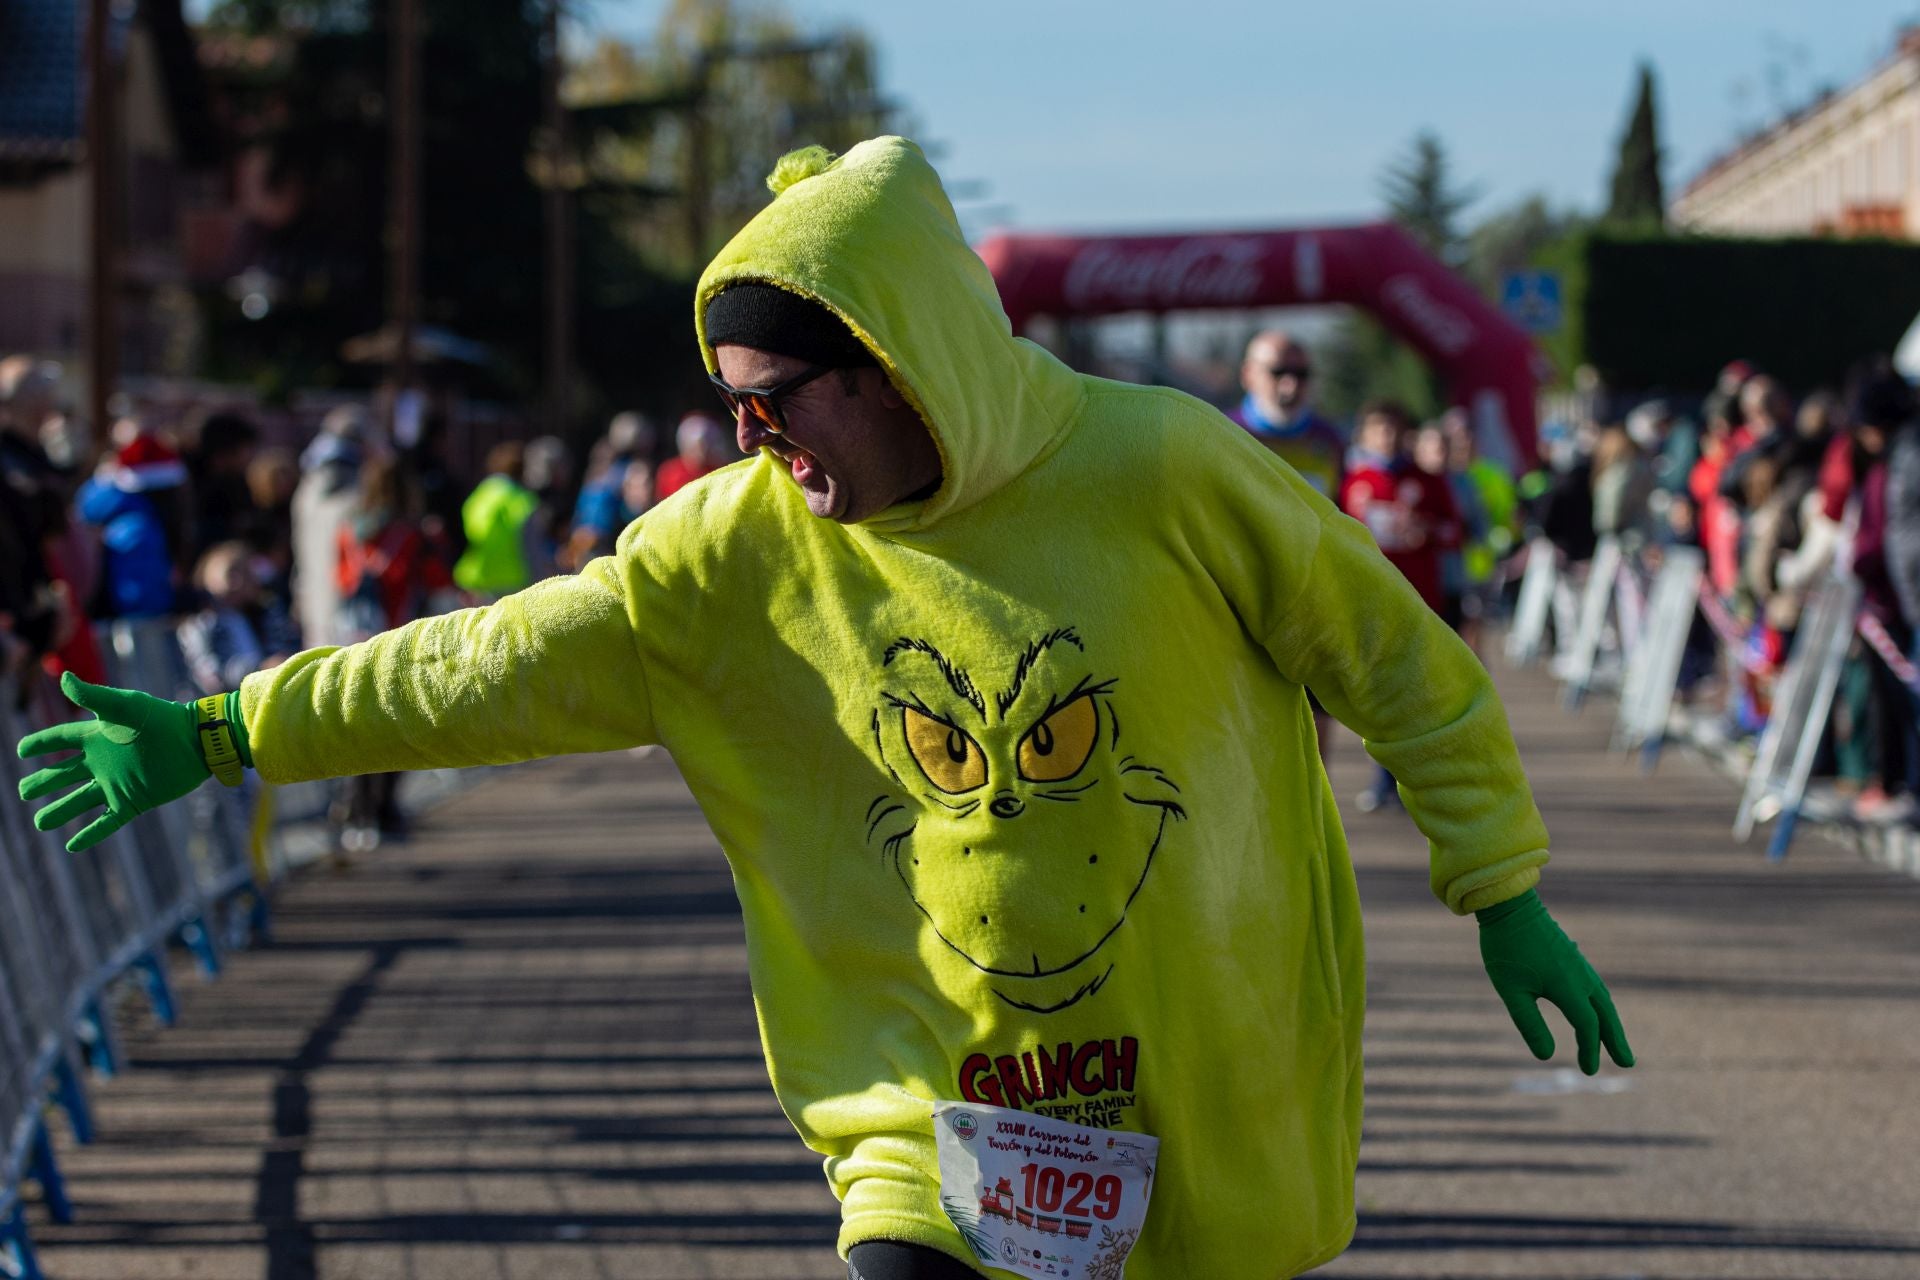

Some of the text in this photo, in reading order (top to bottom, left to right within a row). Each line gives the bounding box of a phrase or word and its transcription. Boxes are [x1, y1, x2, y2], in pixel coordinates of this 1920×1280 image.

[959, 1036, 1139, 1109] GRINCH
[1035, 1095, 1136, 1116] EVERY FAMILY
[1075, 1110, 1123, 1128] ONE
[1023, 1145, 1033, 1157] y
[1020, 1163, 1123, 1221] 1029
